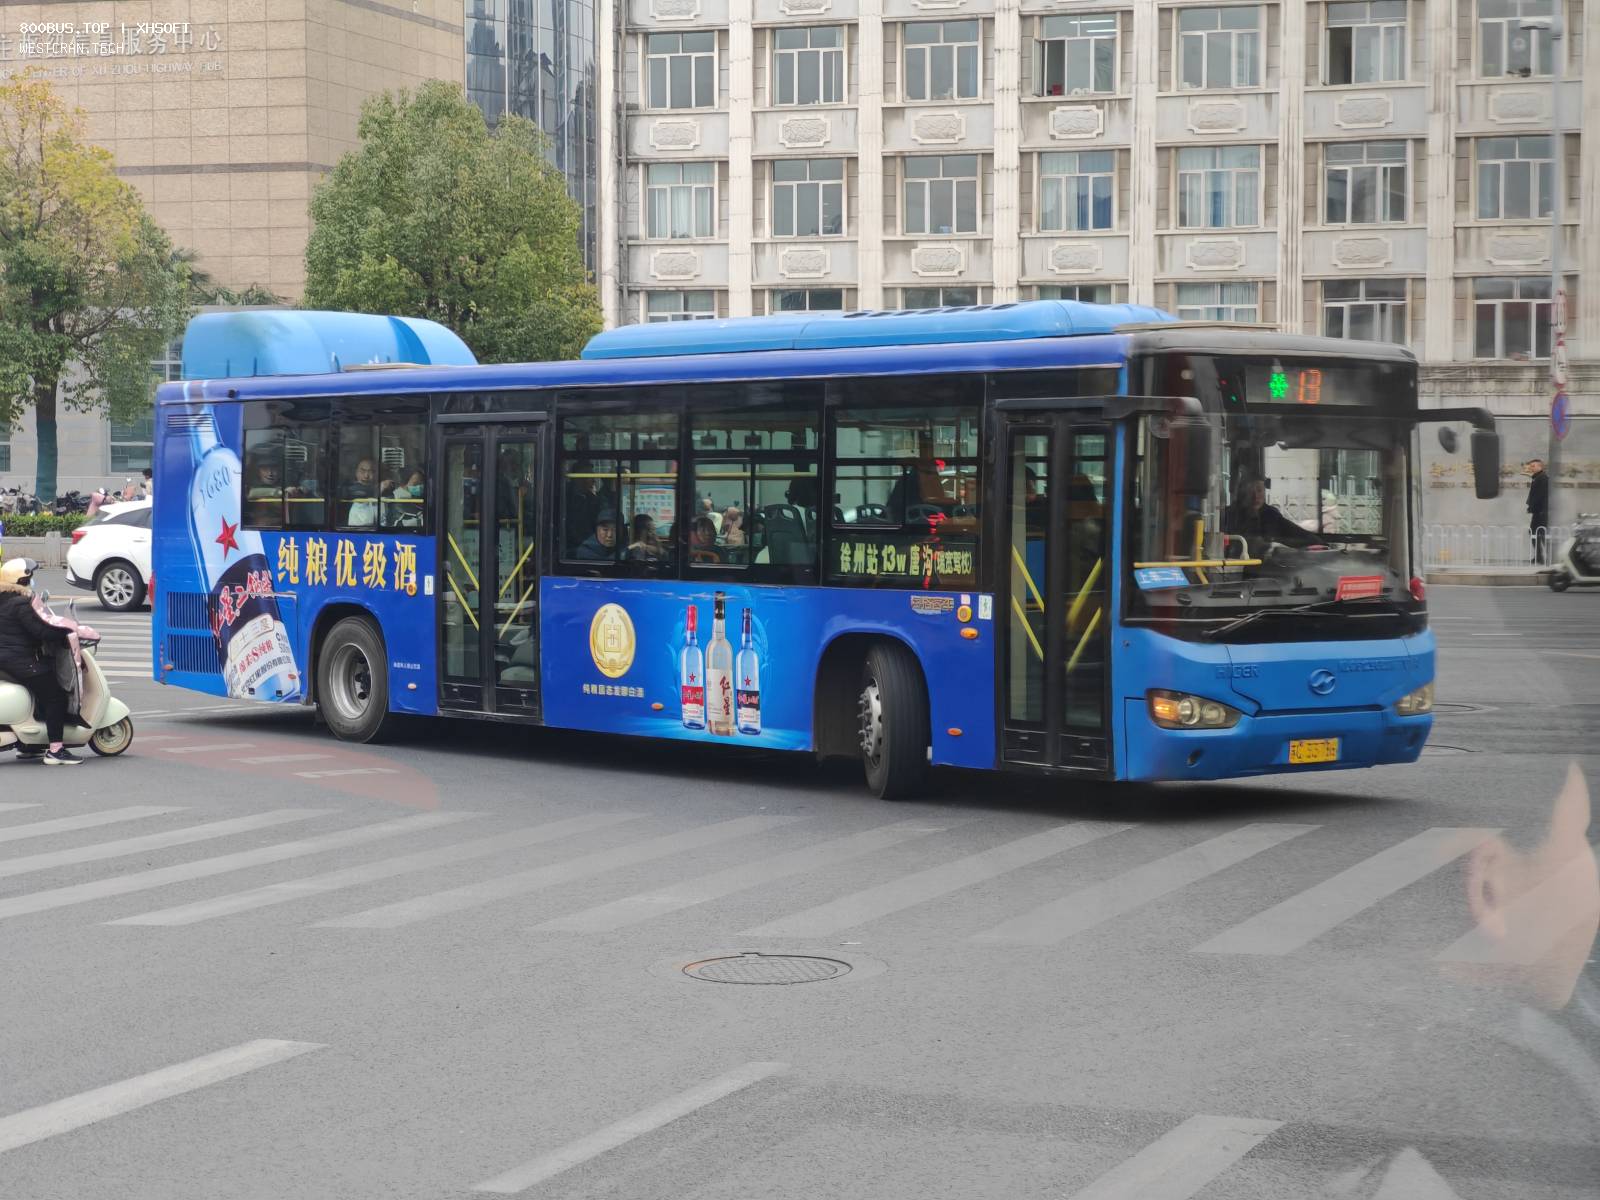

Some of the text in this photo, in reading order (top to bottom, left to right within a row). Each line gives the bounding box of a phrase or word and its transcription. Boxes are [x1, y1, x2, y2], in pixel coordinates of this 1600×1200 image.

[277, 535, 418, 592] 纯粮优级酒
